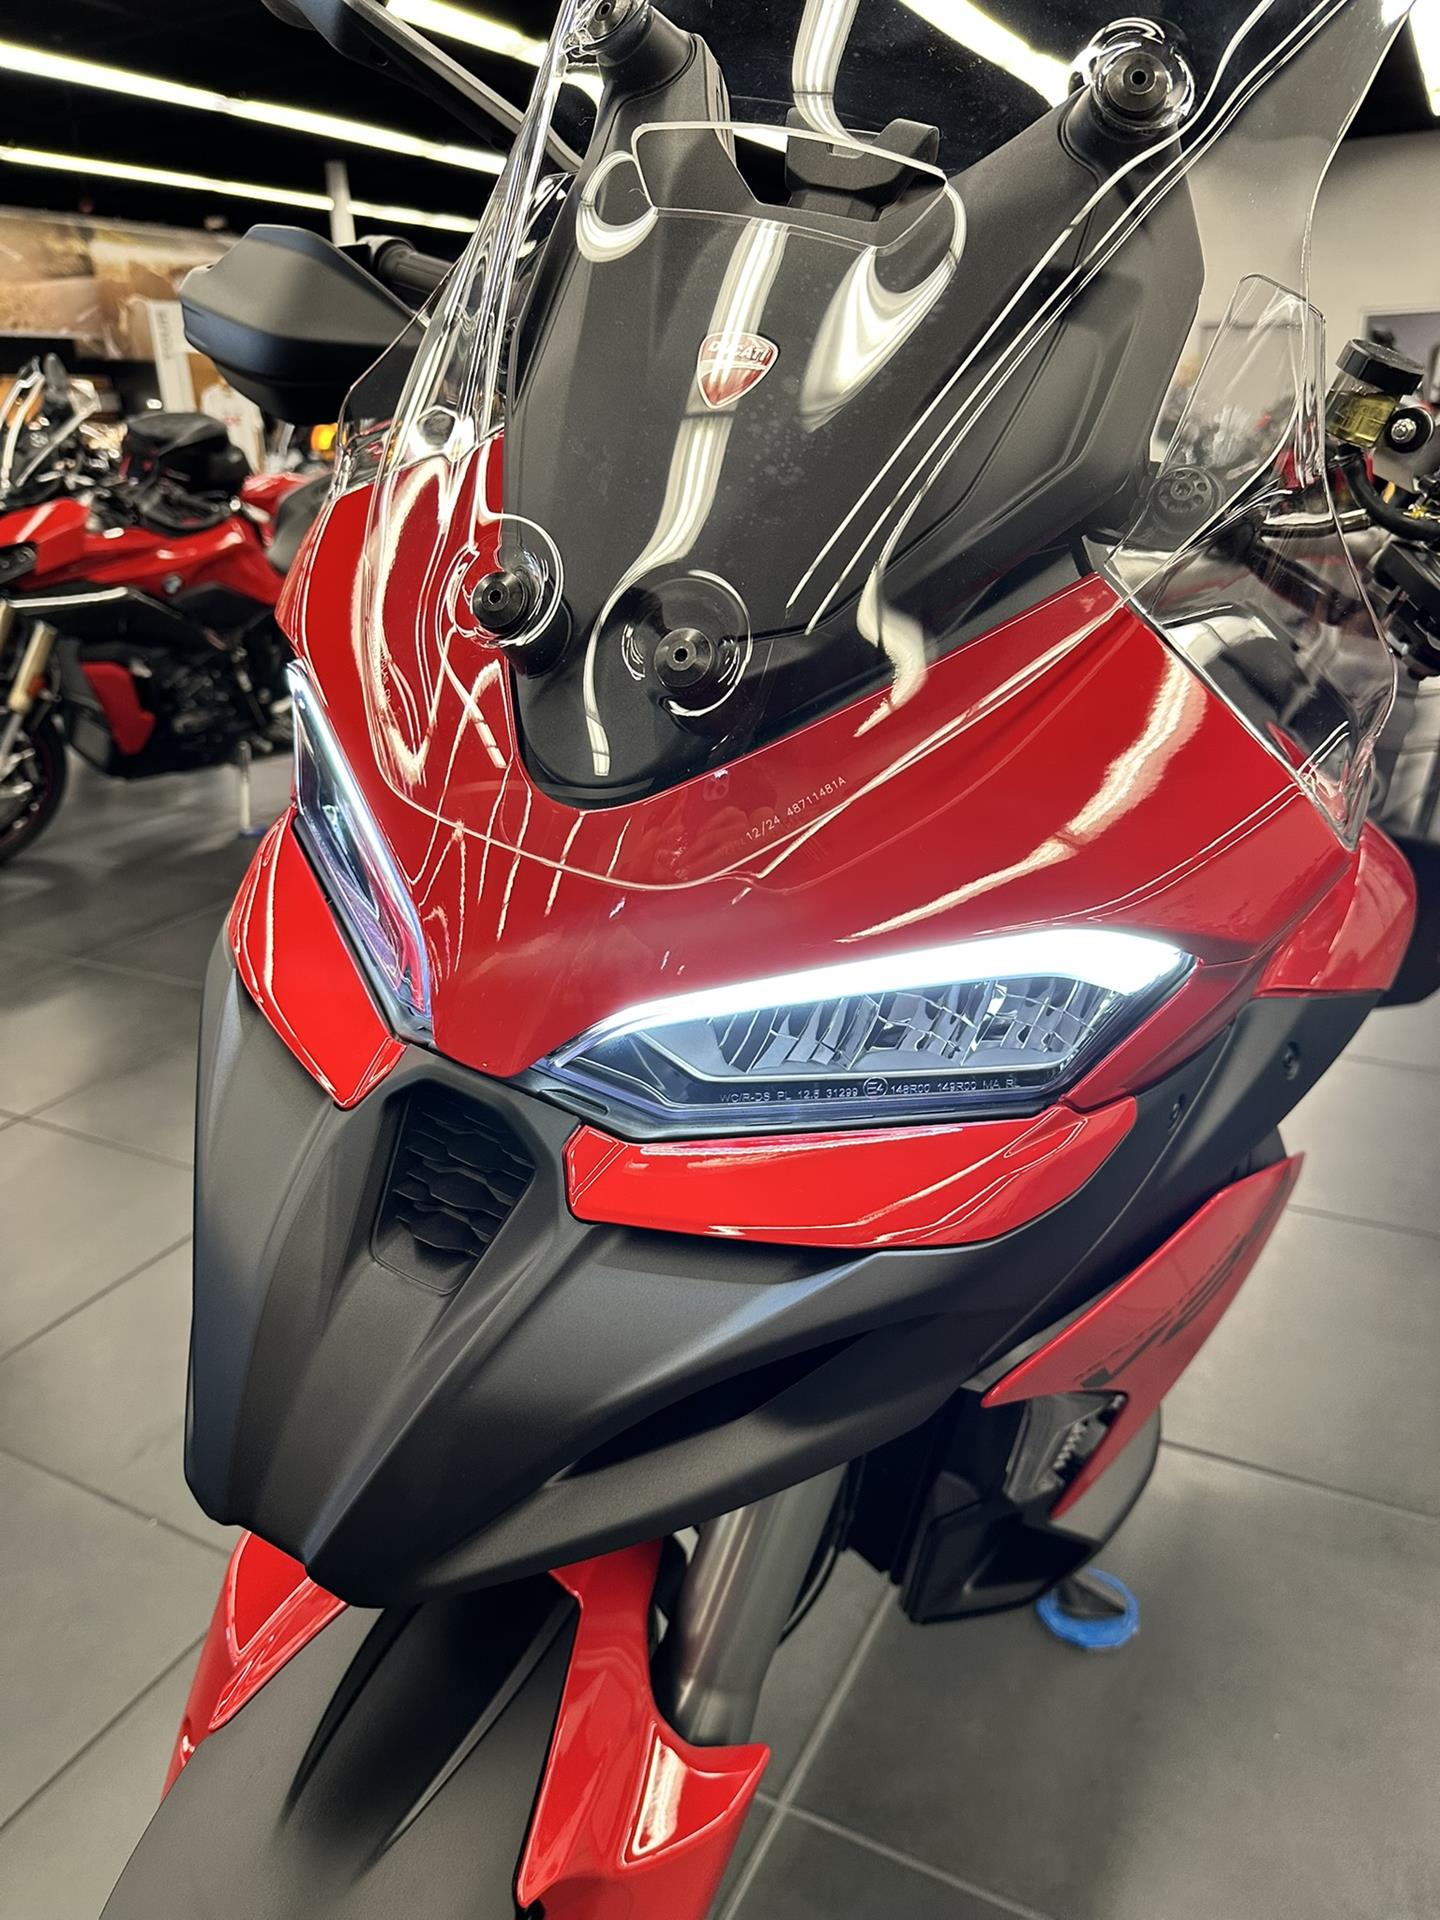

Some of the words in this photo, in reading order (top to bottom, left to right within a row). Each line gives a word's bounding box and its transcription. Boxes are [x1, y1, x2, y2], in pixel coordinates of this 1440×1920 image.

[745, 815, 781, 841] 12/24
[787, 776, 847, 816] 48711481A
[777, 1090, 791, 1100] PL
[826, 1087, 858, 1098] 31299
[866, 1081, 884, 1095] E4
